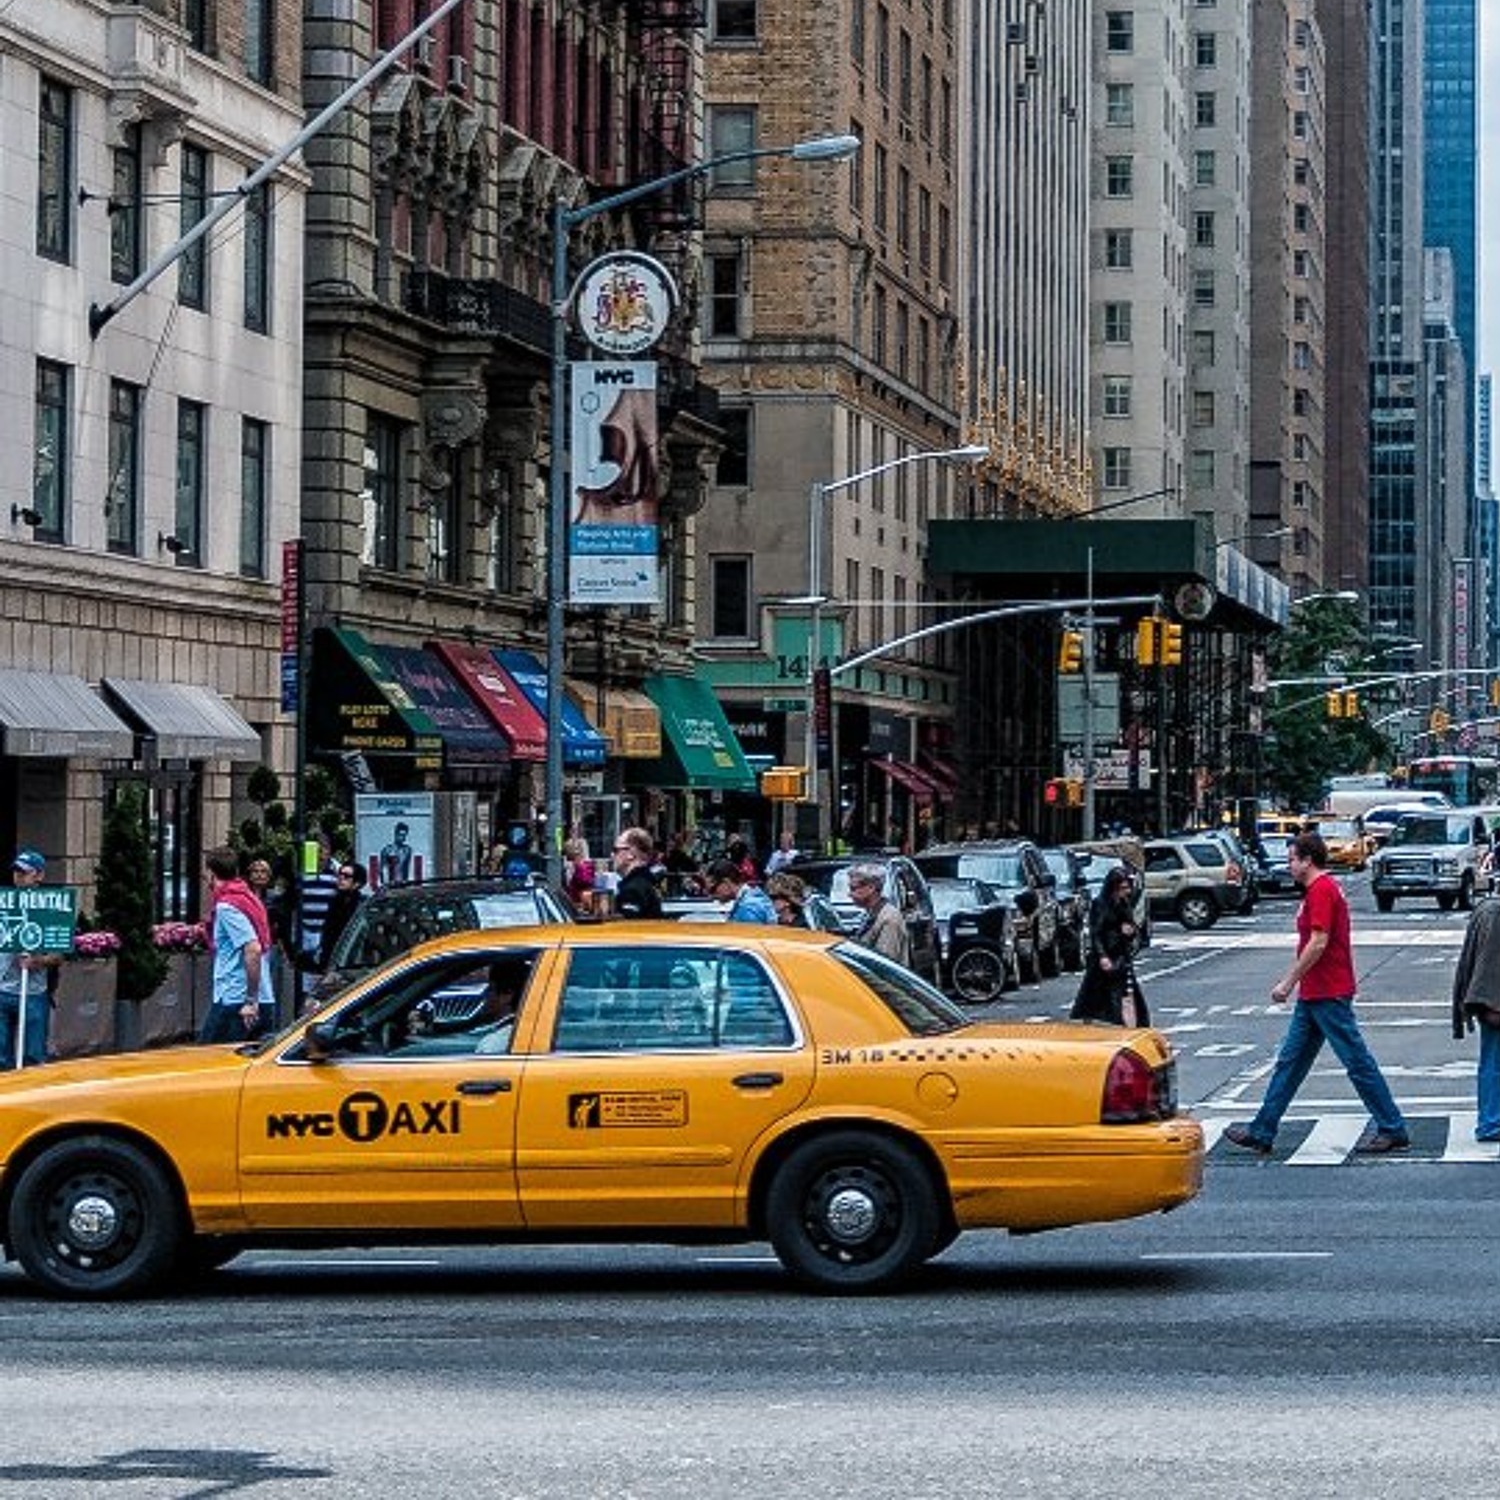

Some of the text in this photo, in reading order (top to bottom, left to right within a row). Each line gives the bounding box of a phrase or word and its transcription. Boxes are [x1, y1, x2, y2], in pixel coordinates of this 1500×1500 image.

[594, 368, 634, 384] NYC
[19, 891, 73, 913] RENTAL
[268, 1090, 461, 1143] NYC TAXI
